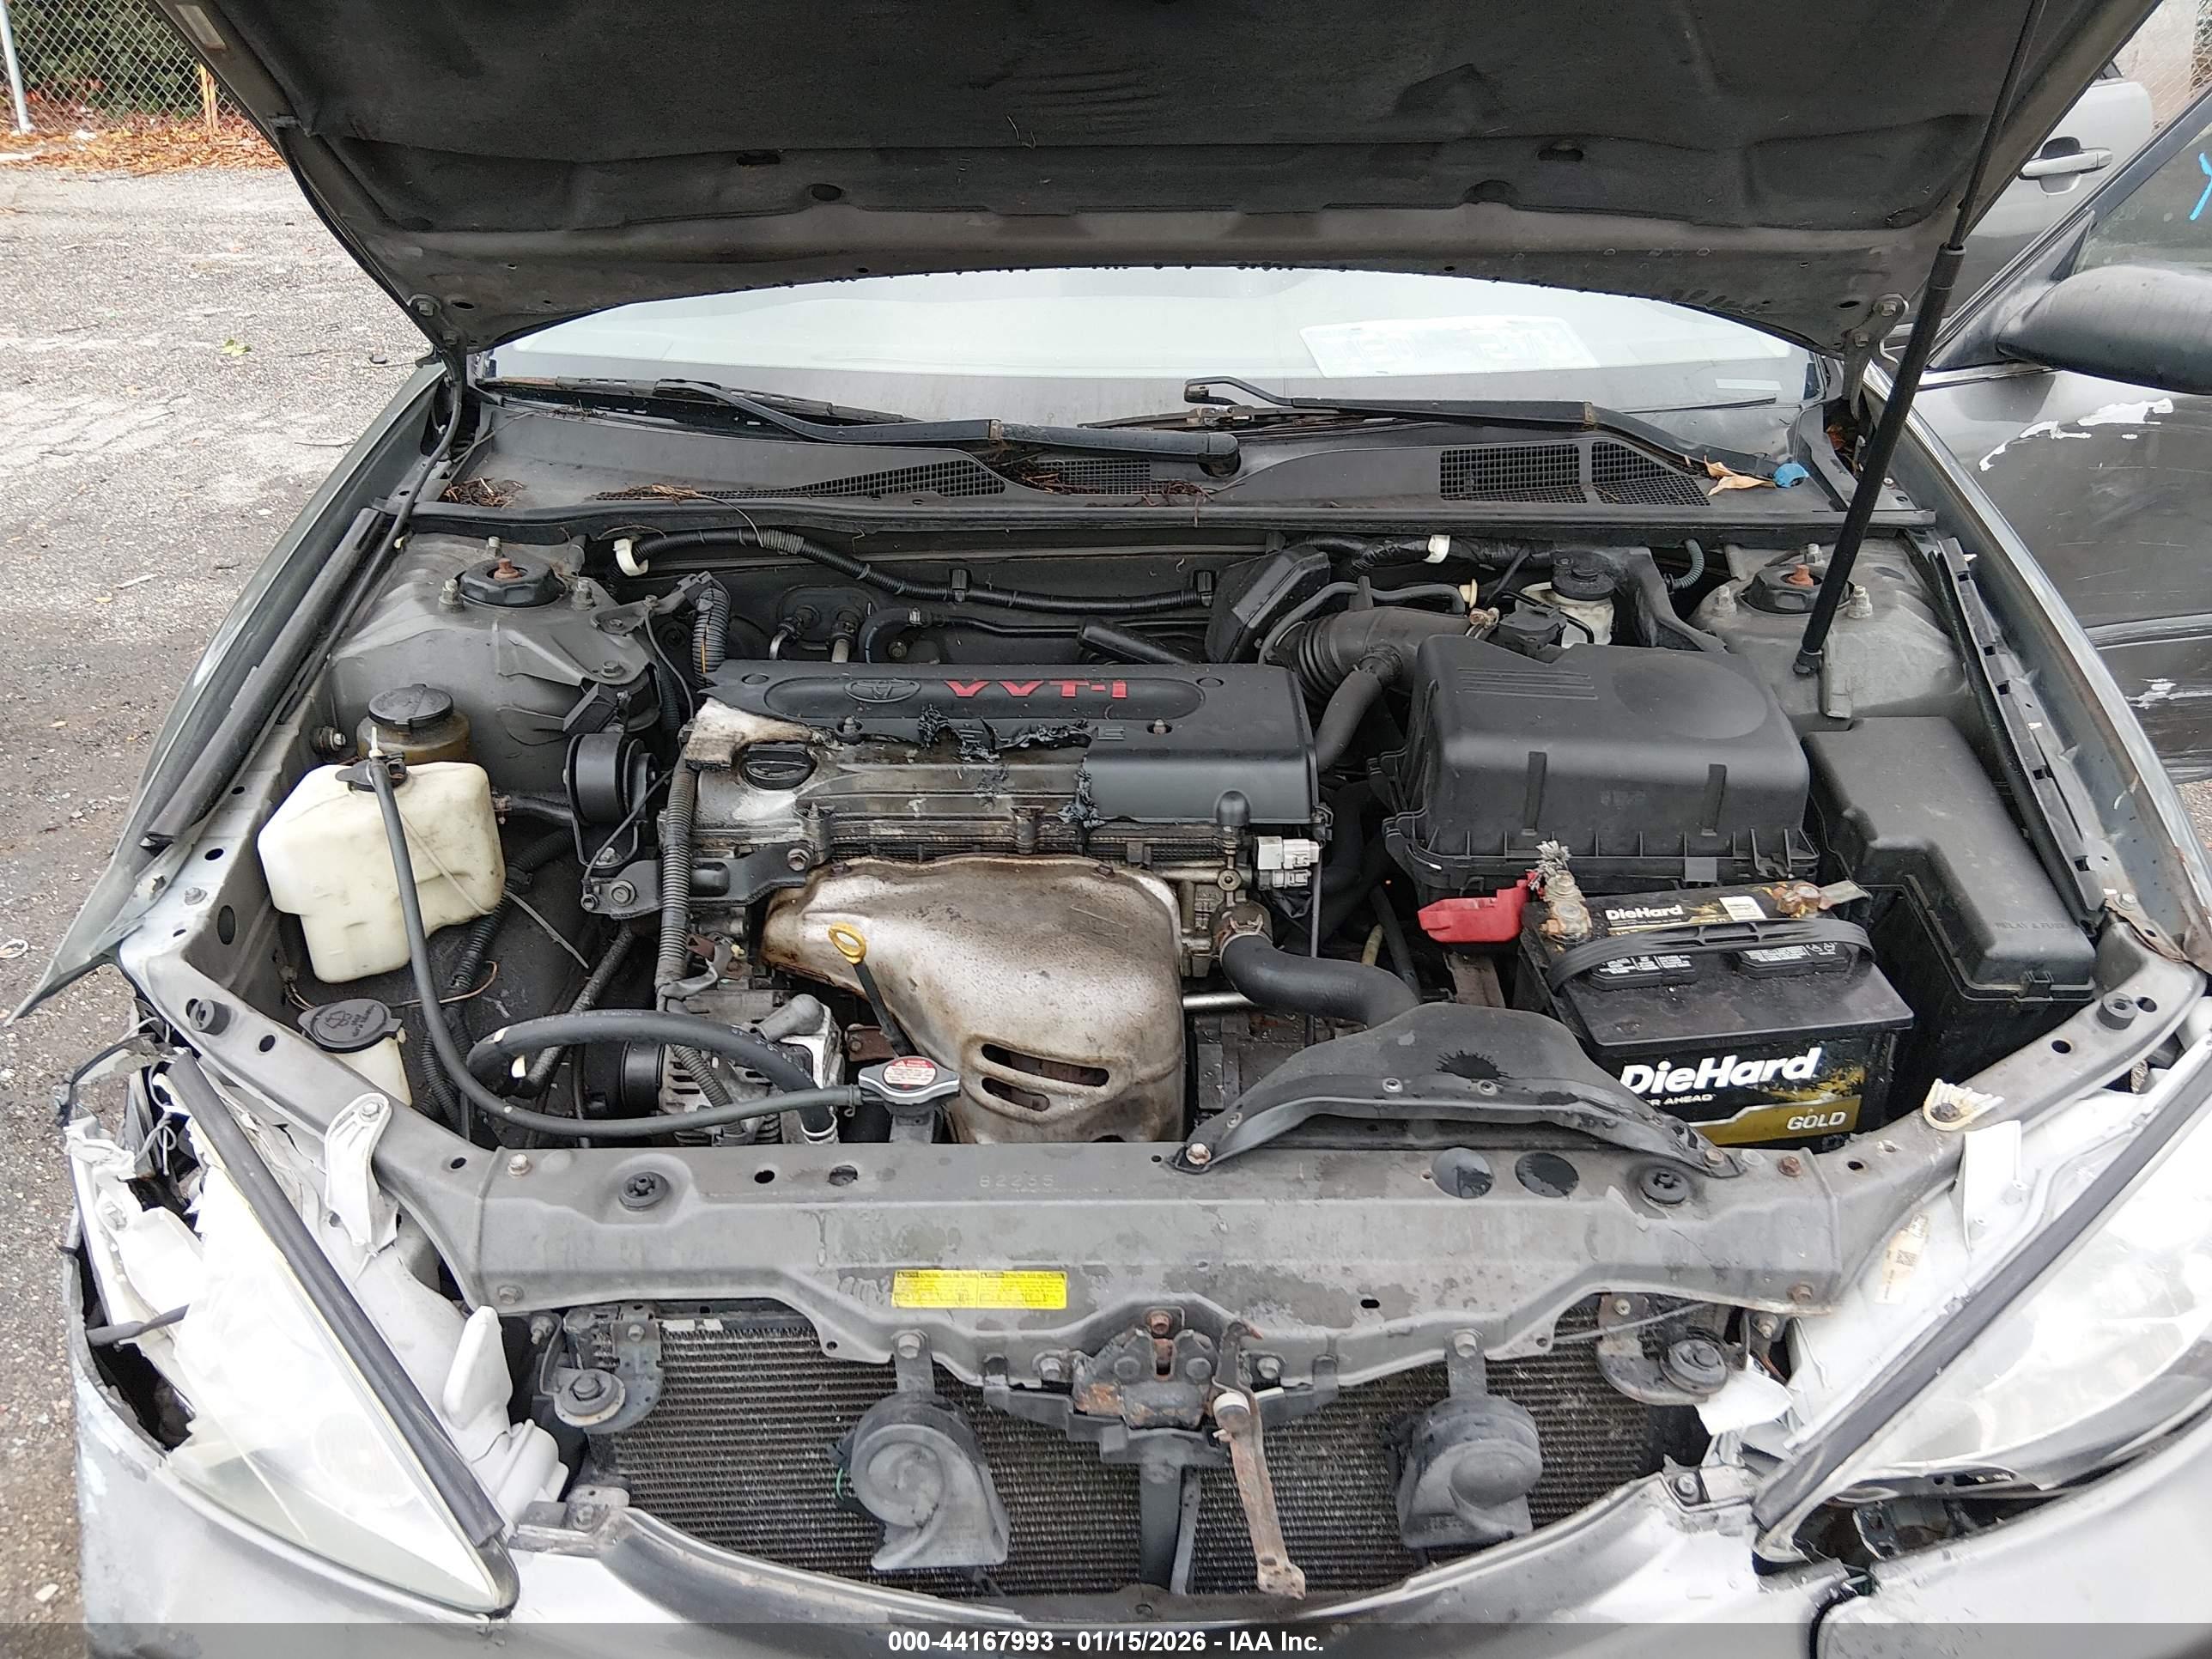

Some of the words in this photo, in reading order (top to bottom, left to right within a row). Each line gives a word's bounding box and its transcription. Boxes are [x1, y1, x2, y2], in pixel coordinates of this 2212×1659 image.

[1605, 905, 1684, 921] DieHard
[1620, 1047, 1823, 1095] DieHard
[1662, 1093, 1714, 1106] AHEAD
[1786, 1110, 1847, 1131] GOLD
